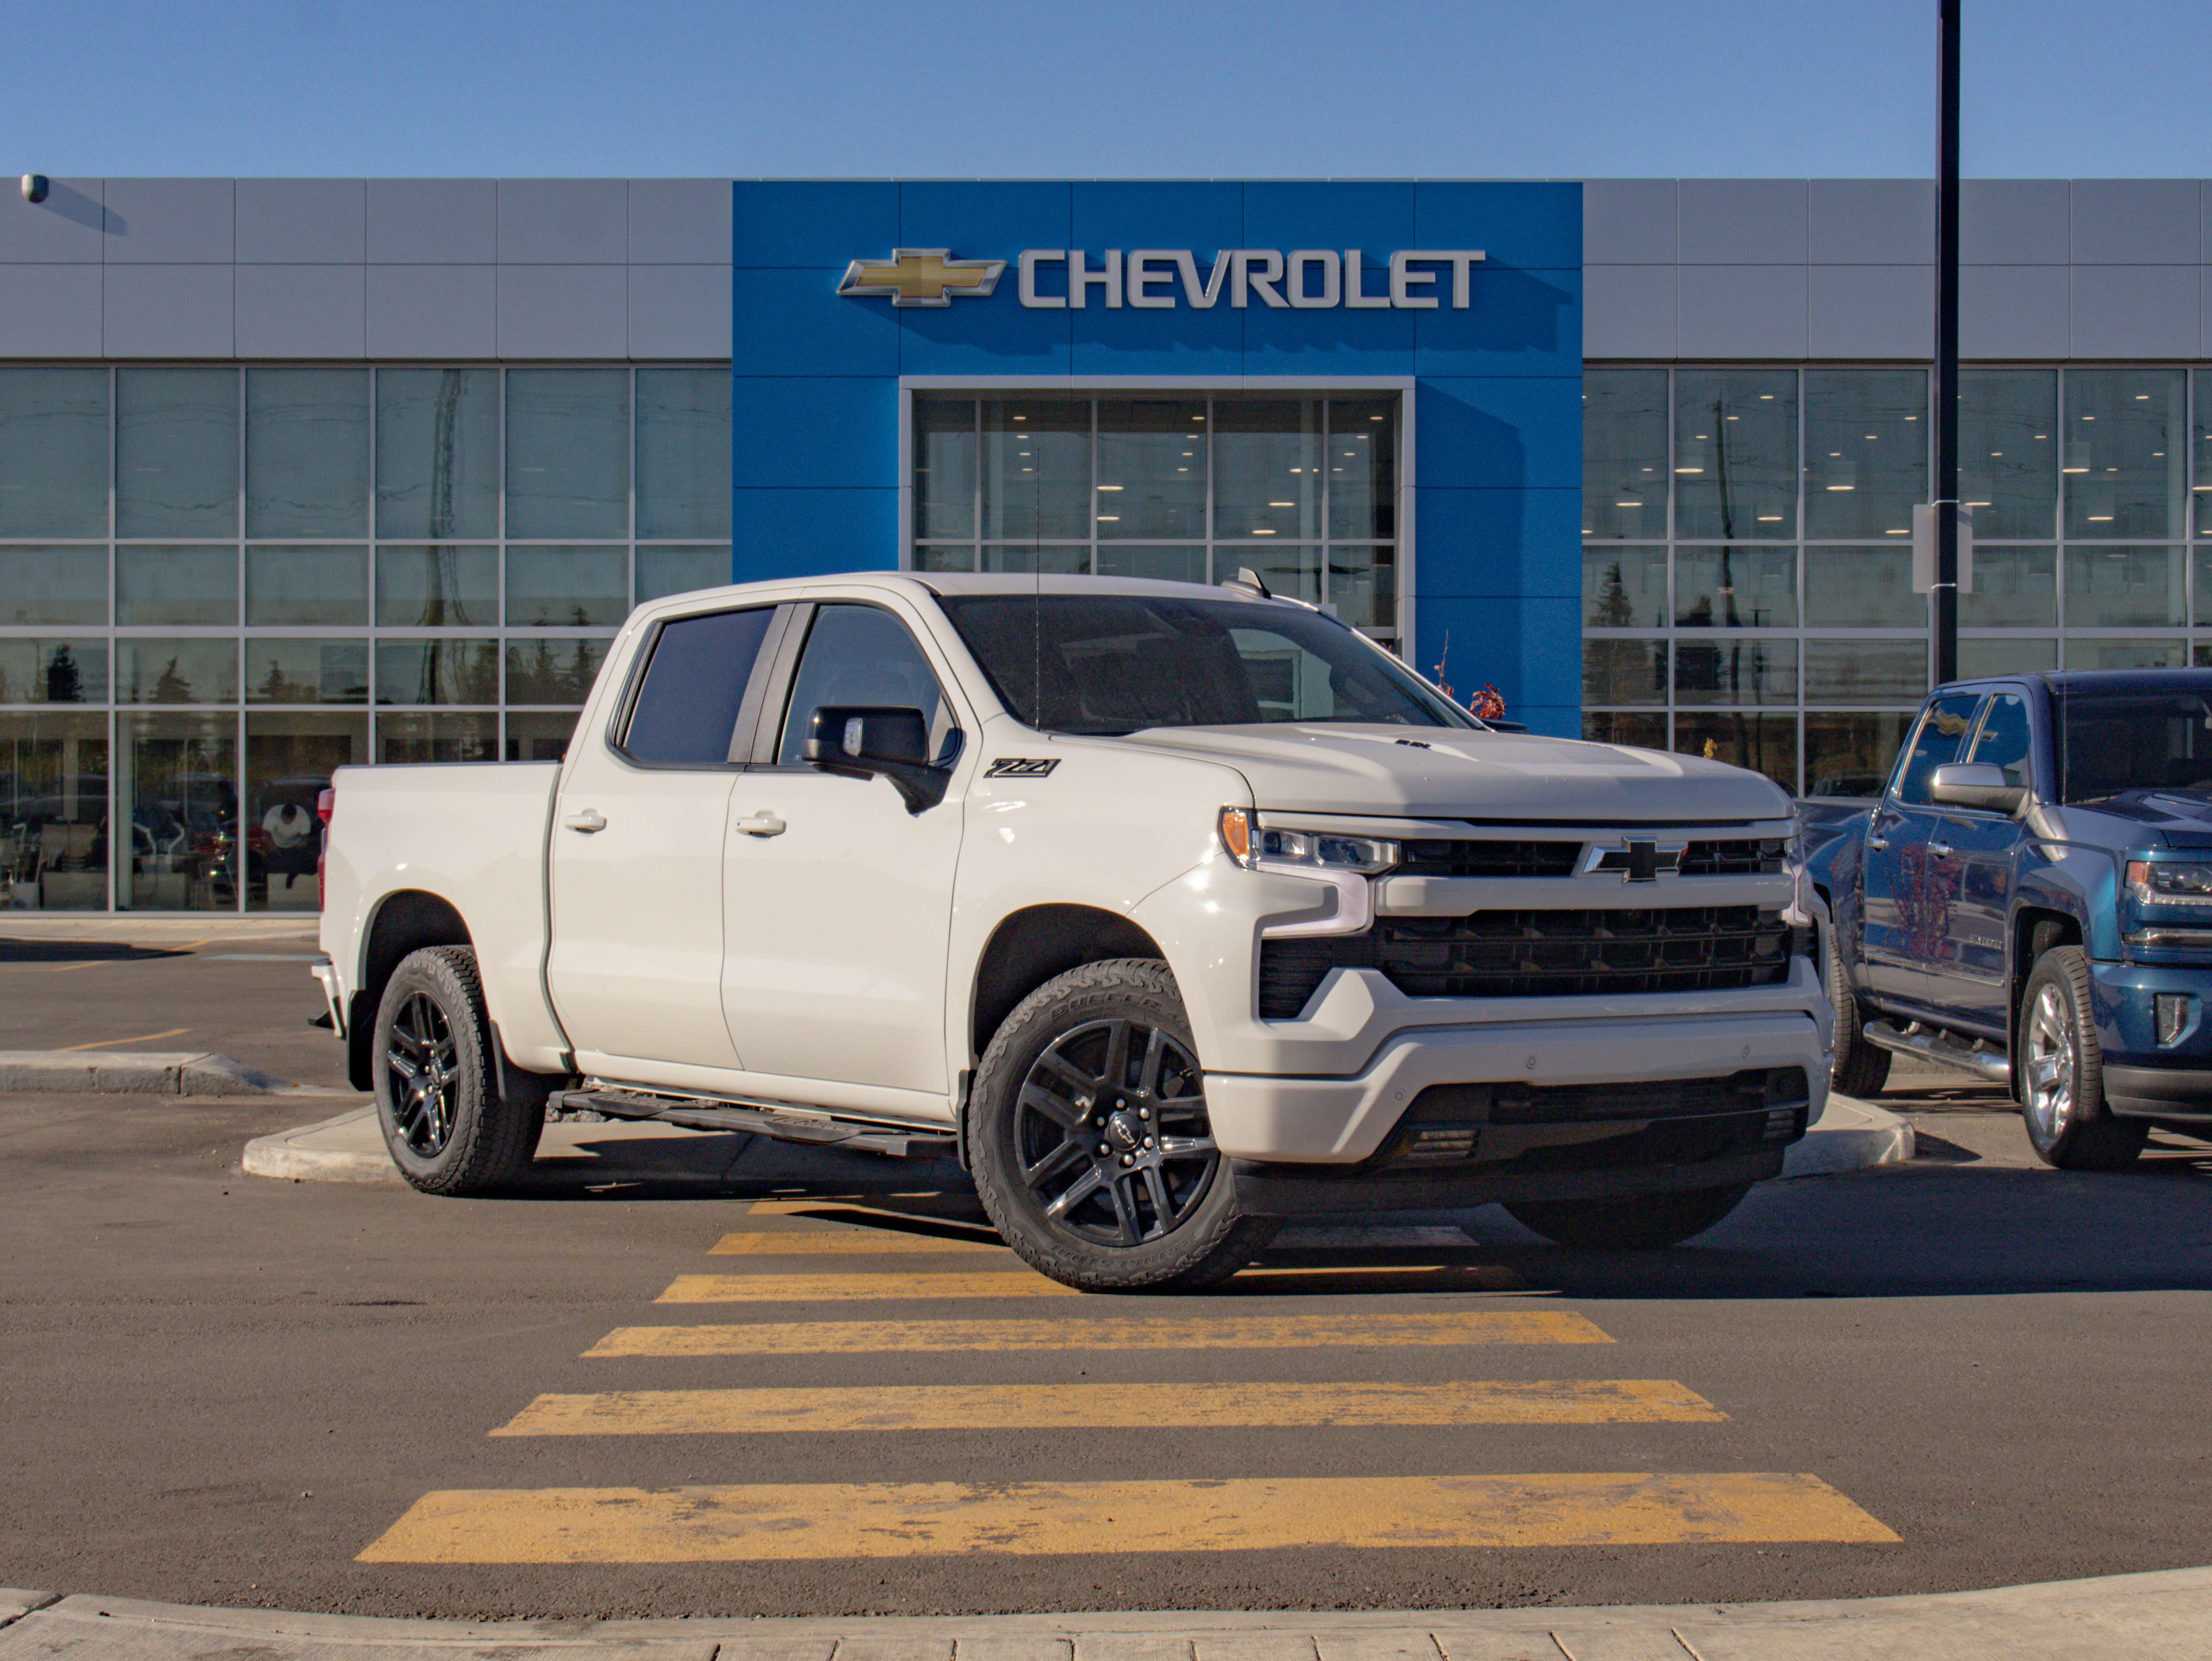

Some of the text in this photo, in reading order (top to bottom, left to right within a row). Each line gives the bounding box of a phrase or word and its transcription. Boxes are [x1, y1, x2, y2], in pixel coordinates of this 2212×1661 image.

[1018, 249, 1486, 309] CHEVROLET
[983, 757, 1062, 778] Z71
[1051, 991, 1162, 1021] DUELER
